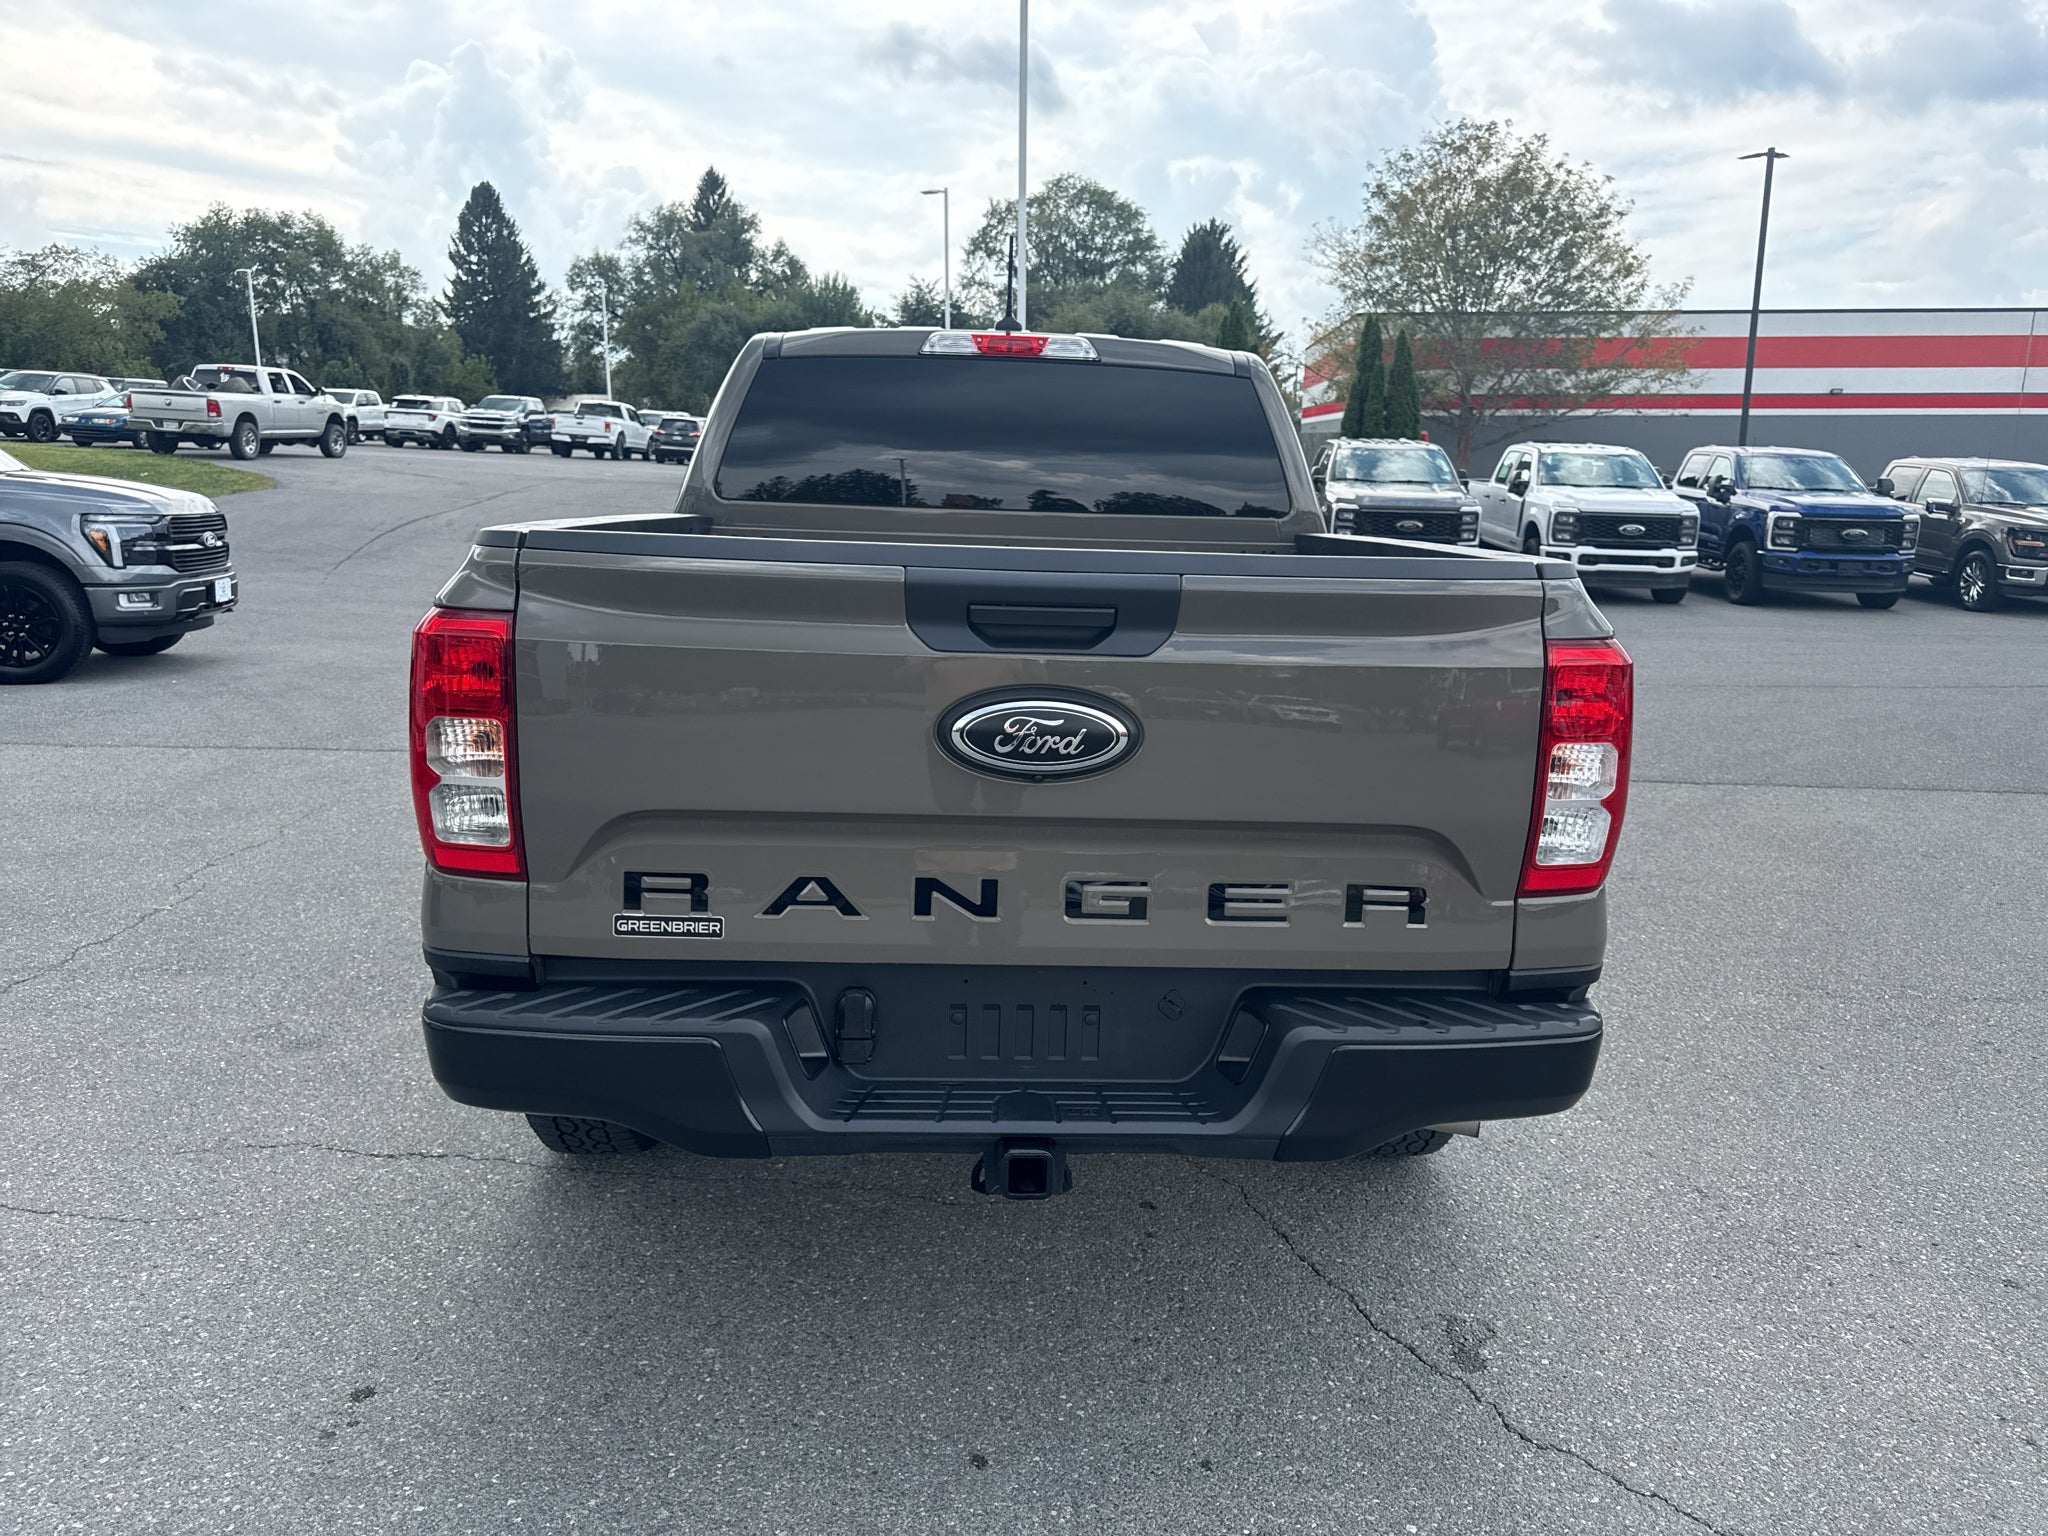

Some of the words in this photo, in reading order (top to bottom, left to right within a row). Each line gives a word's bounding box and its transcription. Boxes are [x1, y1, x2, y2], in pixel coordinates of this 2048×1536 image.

[993, 716, 1087, 755] Ford
[622, 871, 1429, 929] RANGER
[616, 919, 721, 934] GREENBRIER
